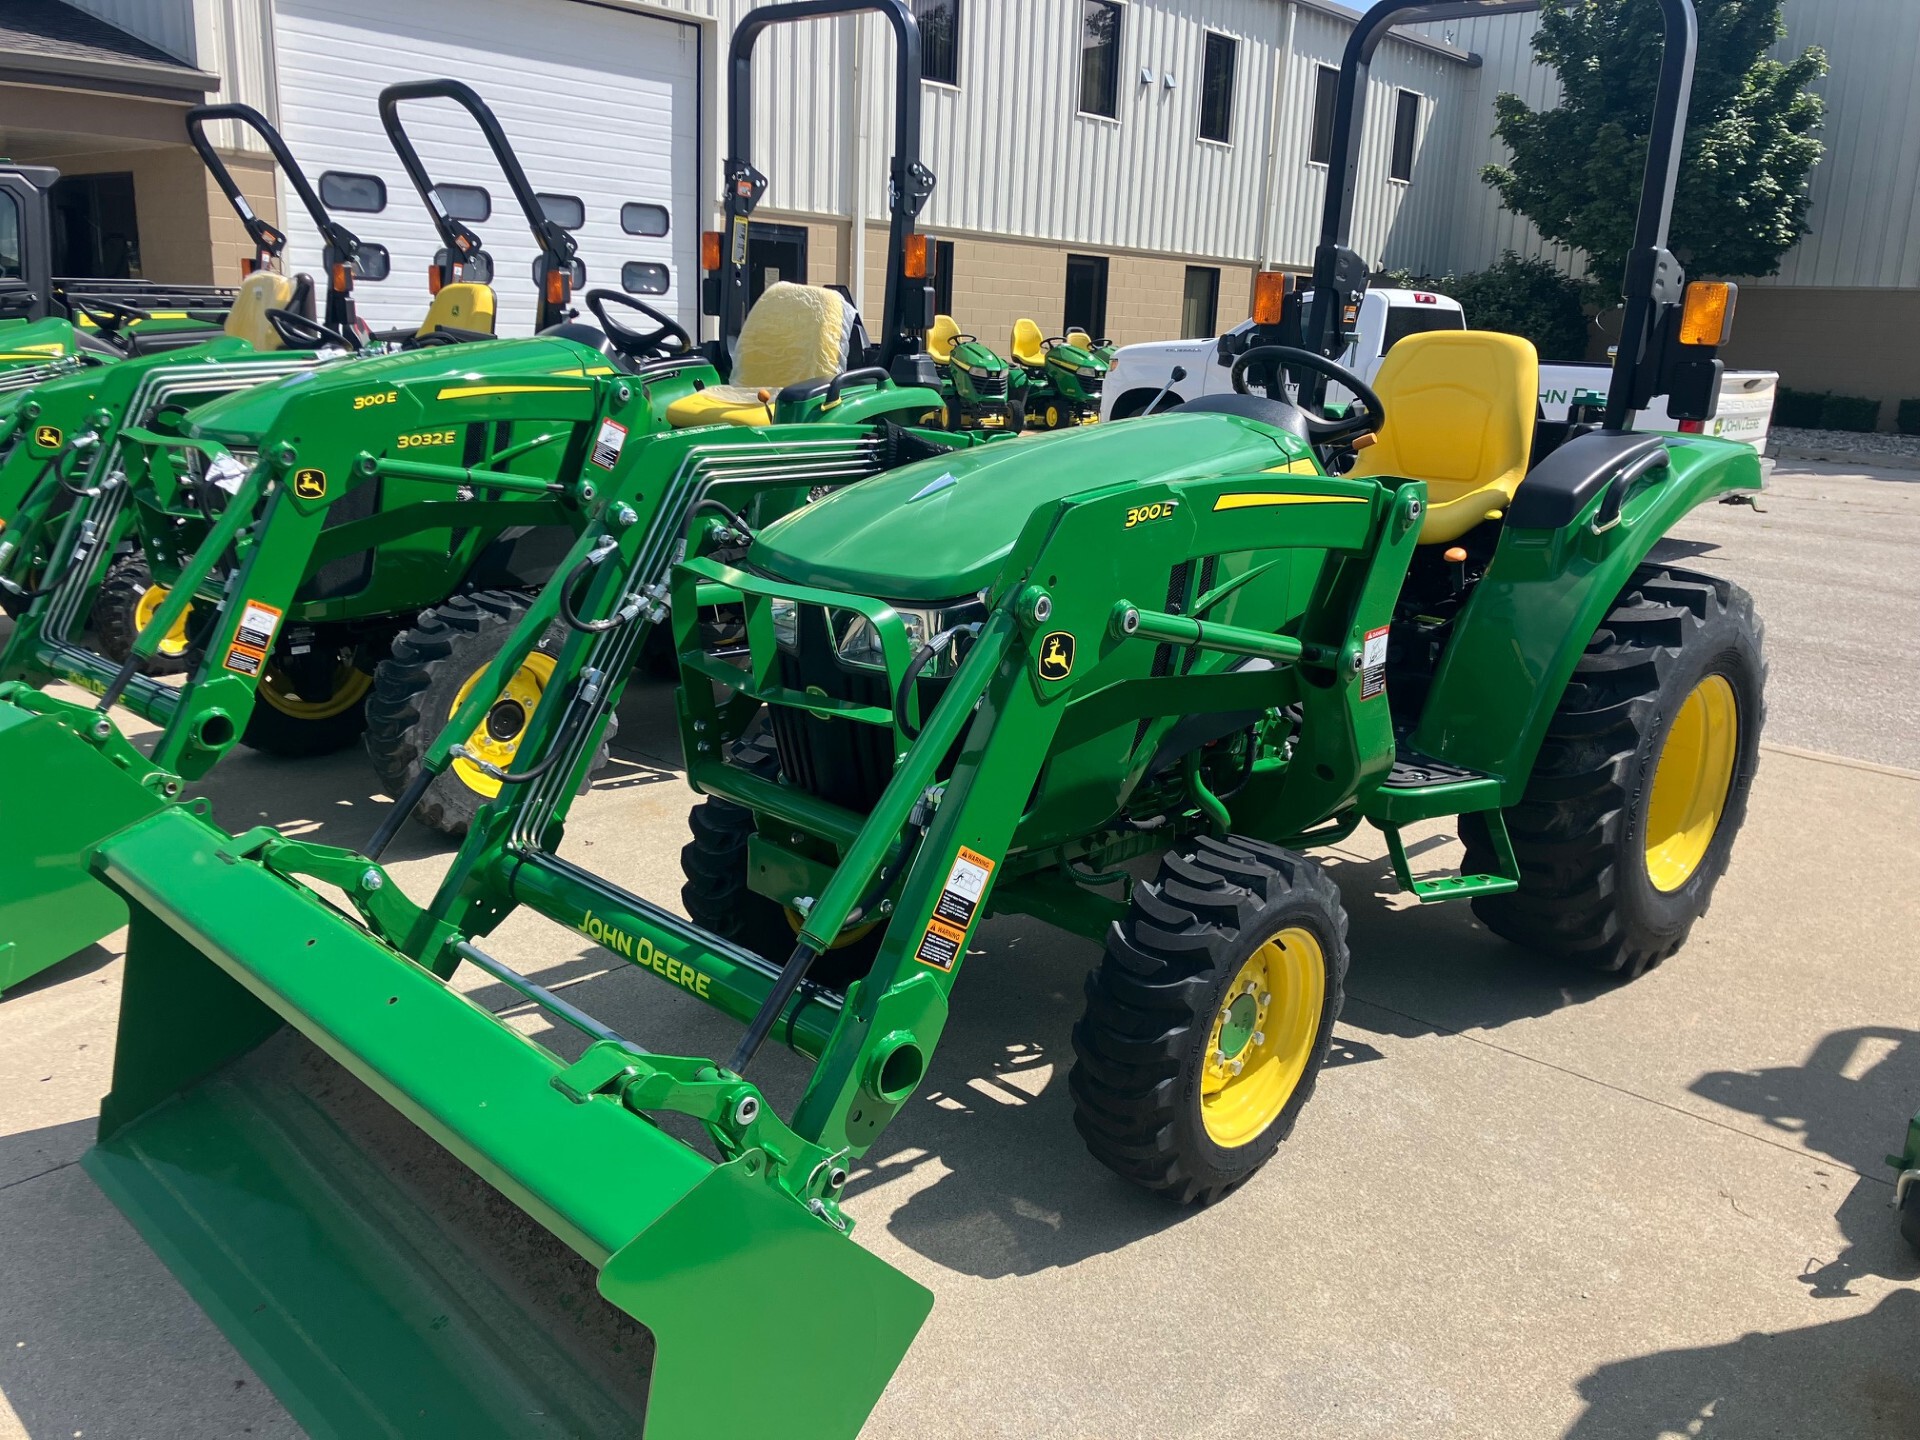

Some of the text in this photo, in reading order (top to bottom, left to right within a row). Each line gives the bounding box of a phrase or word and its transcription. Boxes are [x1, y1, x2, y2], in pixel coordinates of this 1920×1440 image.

[1539, 389, 1567, 404] HN
[1722, 418, 1743, 433] JOHN
[397, 431, 456, 449] 3032E
[967, 852, 990, 869] WARNING
[937, 926, 961, 941] WARNING
[577, 909, 712, 999] JOHN DEERE
